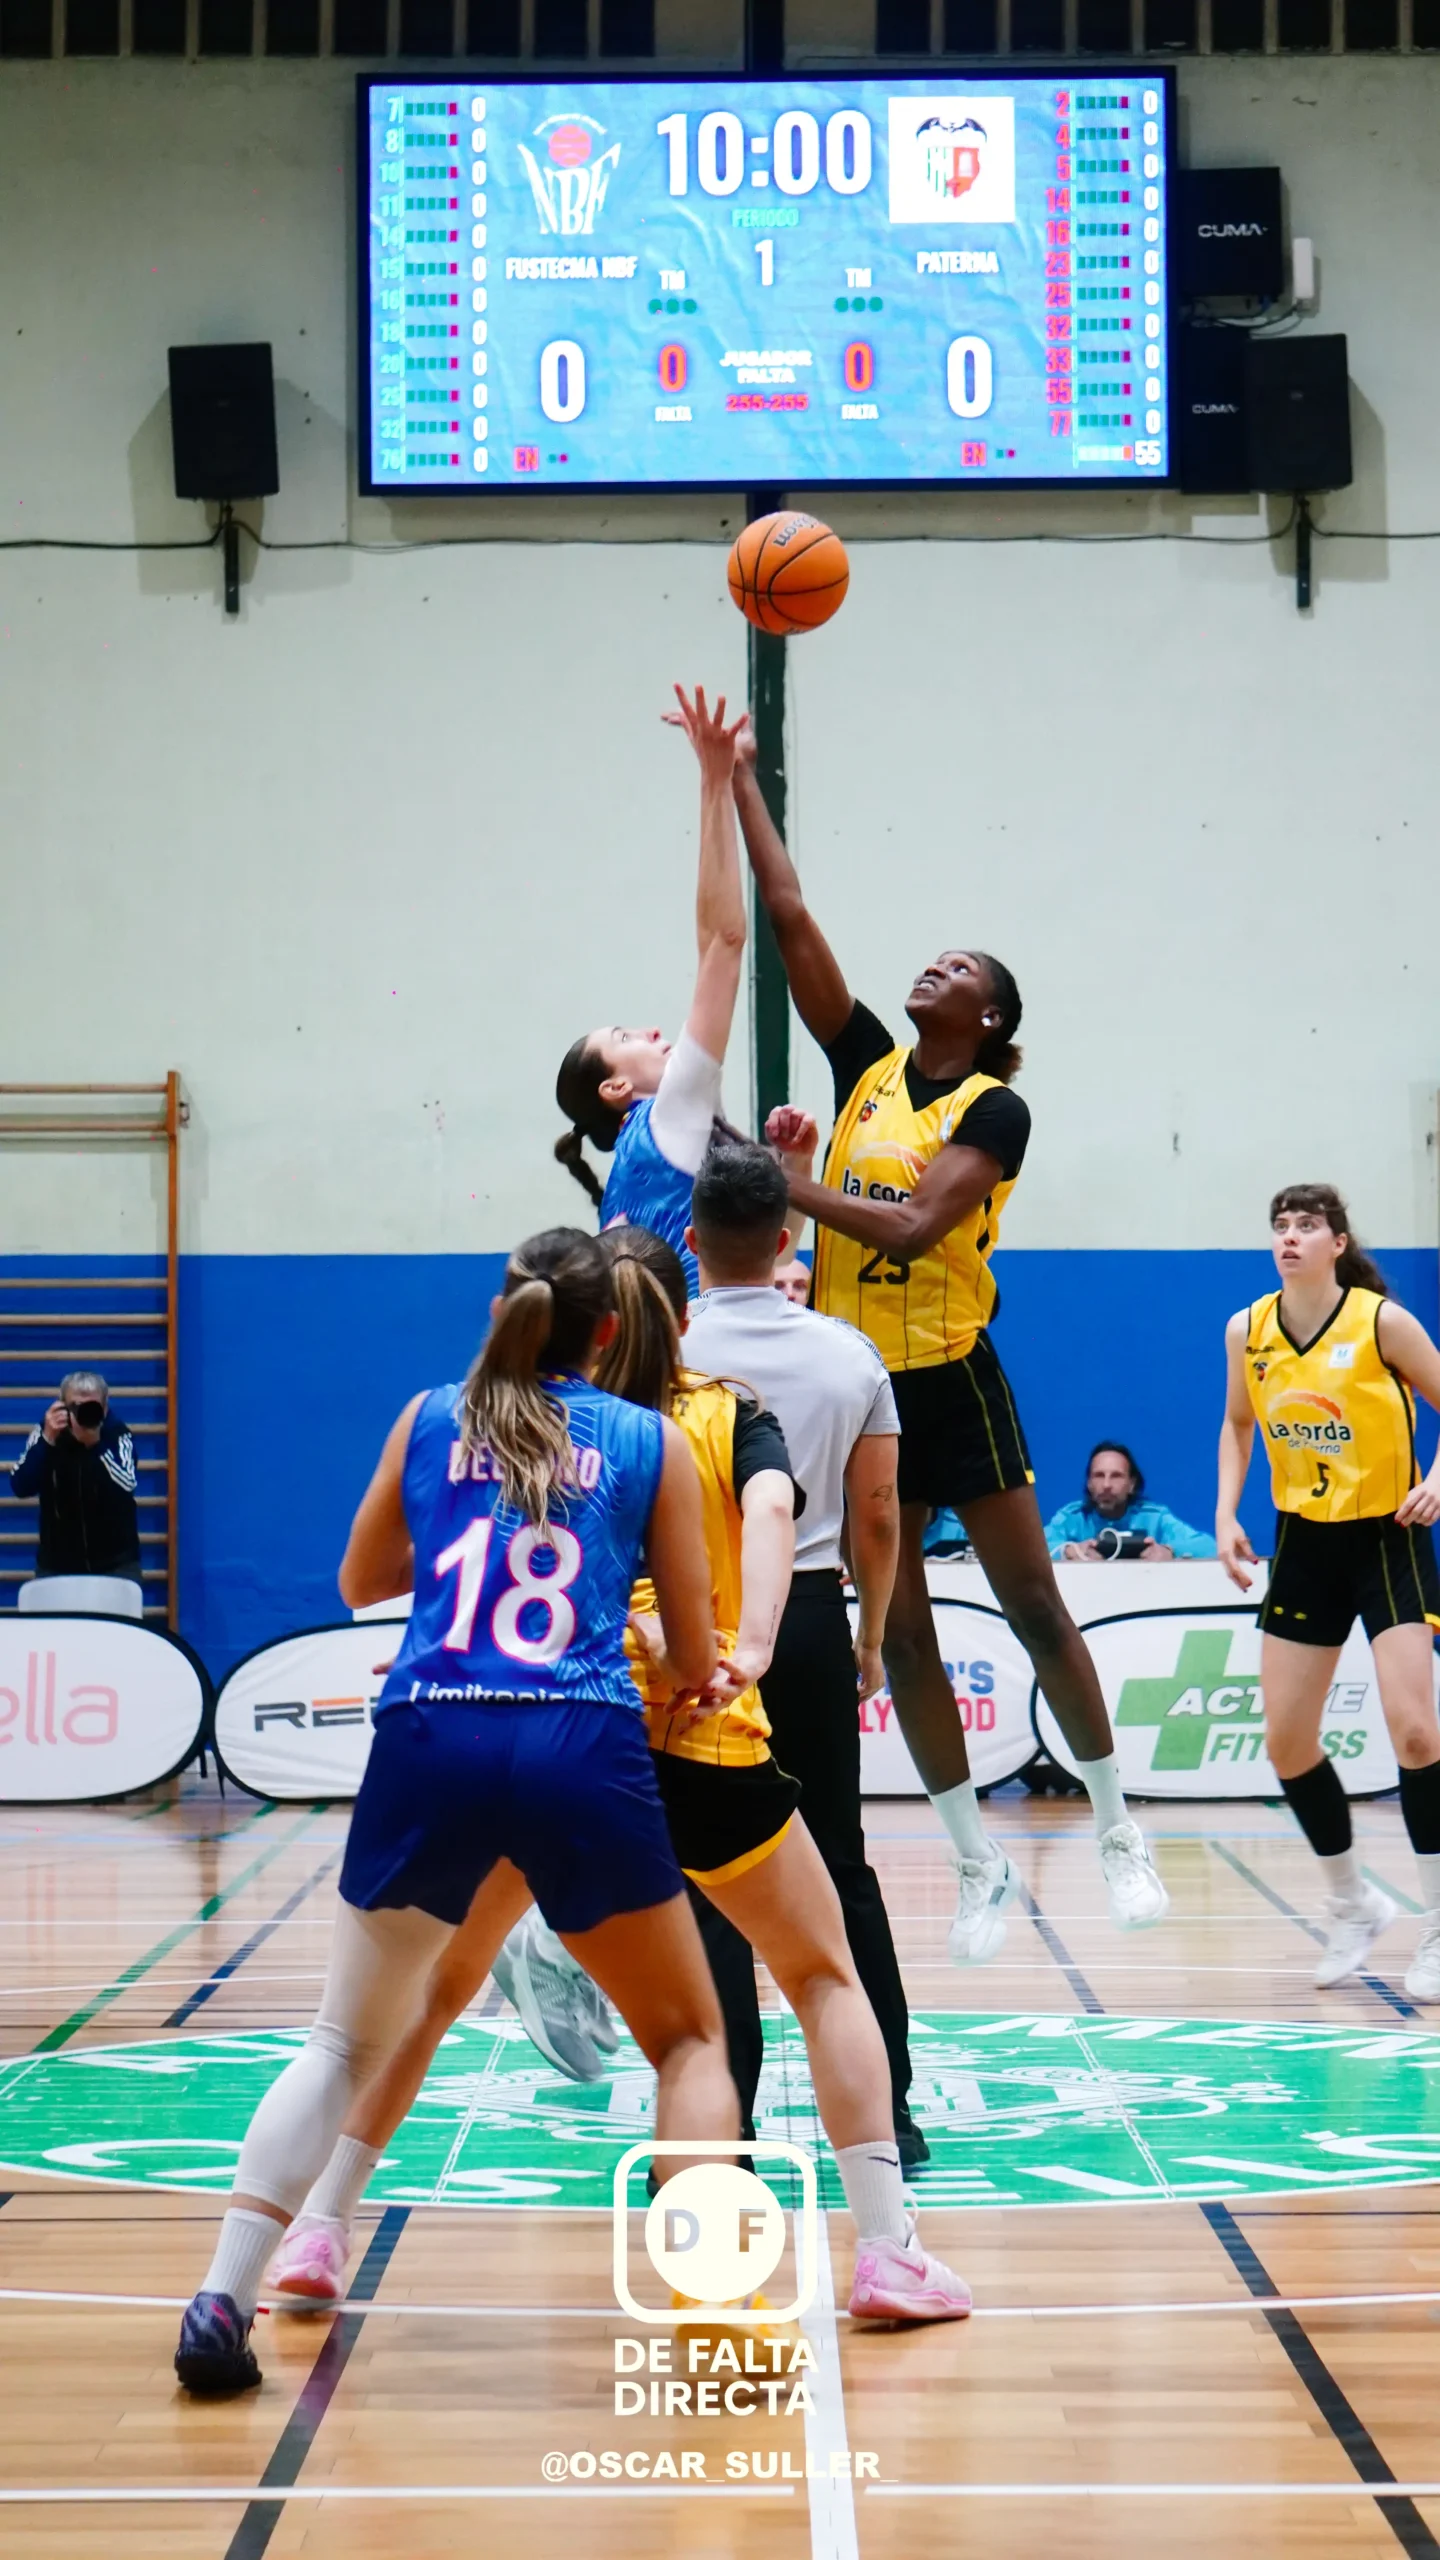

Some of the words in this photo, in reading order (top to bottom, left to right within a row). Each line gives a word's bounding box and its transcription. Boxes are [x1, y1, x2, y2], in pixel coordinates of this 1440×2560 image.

[387, 97, 399, 122] 7
[472, 97, 486, 122] 0
[1056, 91, 1070, 117] 2
[1143, 90, 1158, 114] 0
[385, 129, 399, 153] 8
[472, 128, 486, 152] 0
[1056, 124, 1070, 150] 4
[1143, 121, 1158, 146] 0
[656, 110, 872, 196] 10:00
[472, 160, 486, 185] 0
[1057, 155, 1071, 181] 5
[1144, 153, 1159, 178] 0
[517, 142, 621, 235] NBF
[1045, 187, 1071, 213] 14
[1144, 186, 1159, 211] 0
[379, 194, 399, 217] 11
[472, 193, 486, 218] 0
[731, 207, 799, 228] PERIODO
[472, 224, 486, 249] 0
[1045, 220, 1071, 246] 16
[1144, 217, 1159, 242] 0
[1198, 223, 1262, 238] CUMA
[379, 258, 400, 280] 15
[472, 256, 486, 281] 0
[505, 257, 598, 280] FUSTECMA
[602, 256, 638, 279] NBF
[755, 239, 774, 286] 1
[916, 251, 1000, 273] PATERNA
[1045, 251, 1071, 277] 23
[1144, 249, 1159, 275] 0
[658, 269, 686, 290] TM
[844, 267, 872, 288] TM
[472, 287, 487, 312] 0
[1045, 281, 1071, 308] 25
[1144, 280, 1159, 306] 0
[472, 320, 487, 345] 0
[1045, 314, 1071, 340] 32
[1145, 313, 1160, 338] 0
[473, 350, 487, 376] 0
[659, 343, 687, 392] 0
[844, 341, 873, 392] 0
[1045, 347, 1072, 373] 33
[1145, 344, 1160, 369] 0
[540, 340, 586, 423] 0
[946, 336, 992, 418] 0
[1046, 378, 1072, 404] 55
[1145, 376, 1160, 402] 0
[473, 383, 488, 408] 0
[725, 393, 809, 412] 255-255
[1192, 403, 1236, 414] CUMA
[380, 418, 401, 439] 32
[473, 415, 488, 441] 0
[1050, 410, 1072, 437] 77
[1146, 409, 1160, 434] 0
[473, 447, 488, 472] 0
[1134, 440, 1161, 466] 55
[869, 1182, 911, 1203] cor
[1310, 1462, 1330, 1498] 5
[435, 1517, 583, 1666] 18
